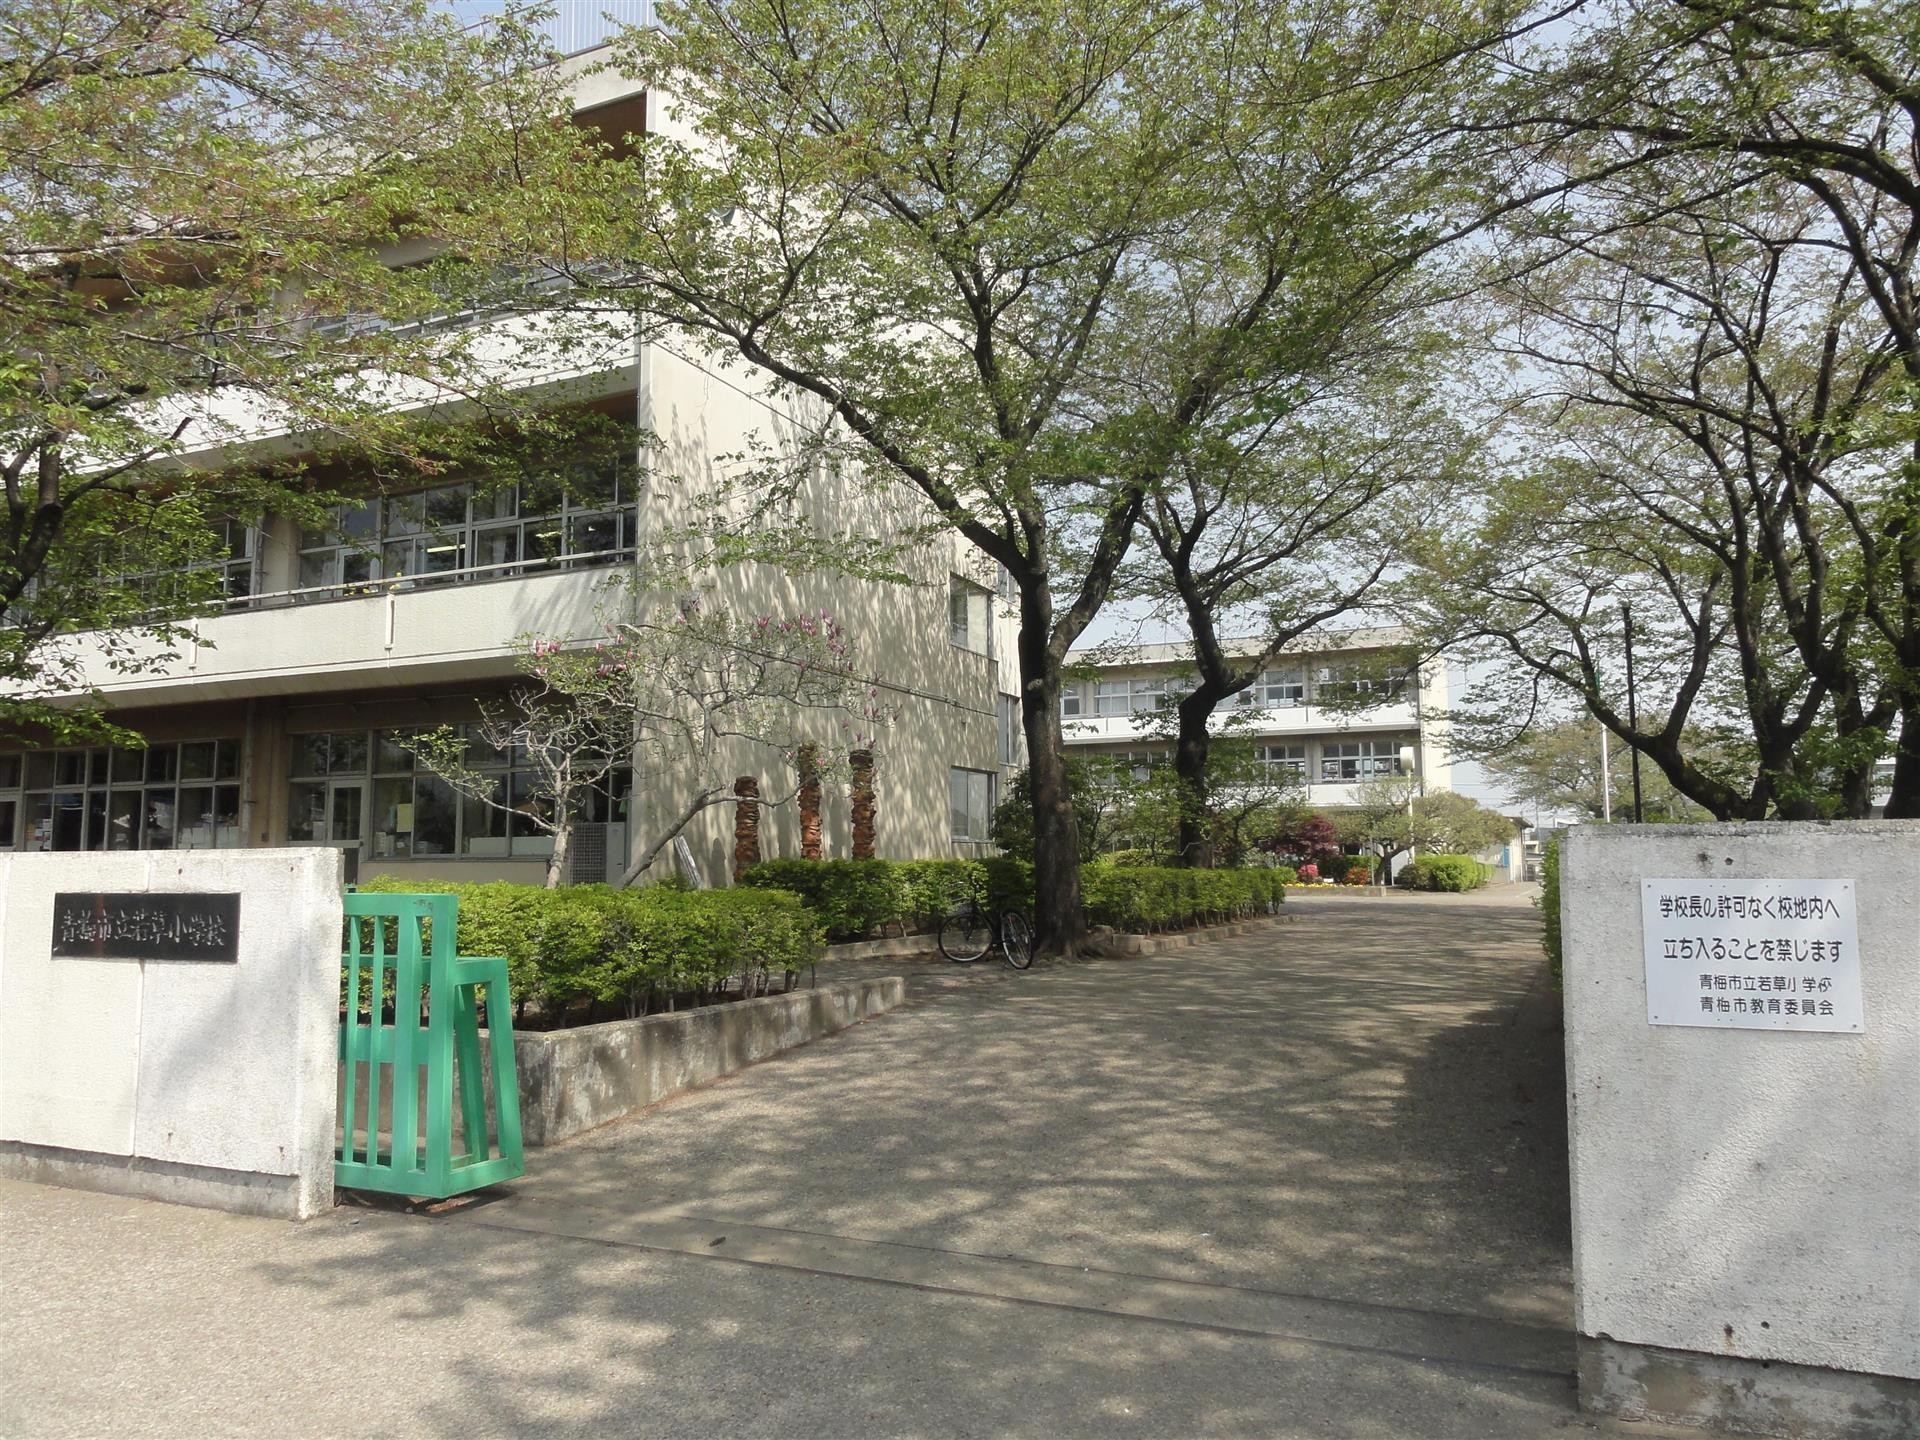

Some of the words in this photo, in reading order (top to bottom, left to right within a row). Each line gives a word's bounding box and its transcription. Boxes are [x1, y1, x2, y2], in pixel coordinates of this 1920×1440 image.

[1659, 895, 1840, 919] 学校長の許可なく校地内へ
[1663, 937, 1843, 962] 立ち入ることを禁じます
[1700, 996, 1834, 1016] 青梅市教育委員会
